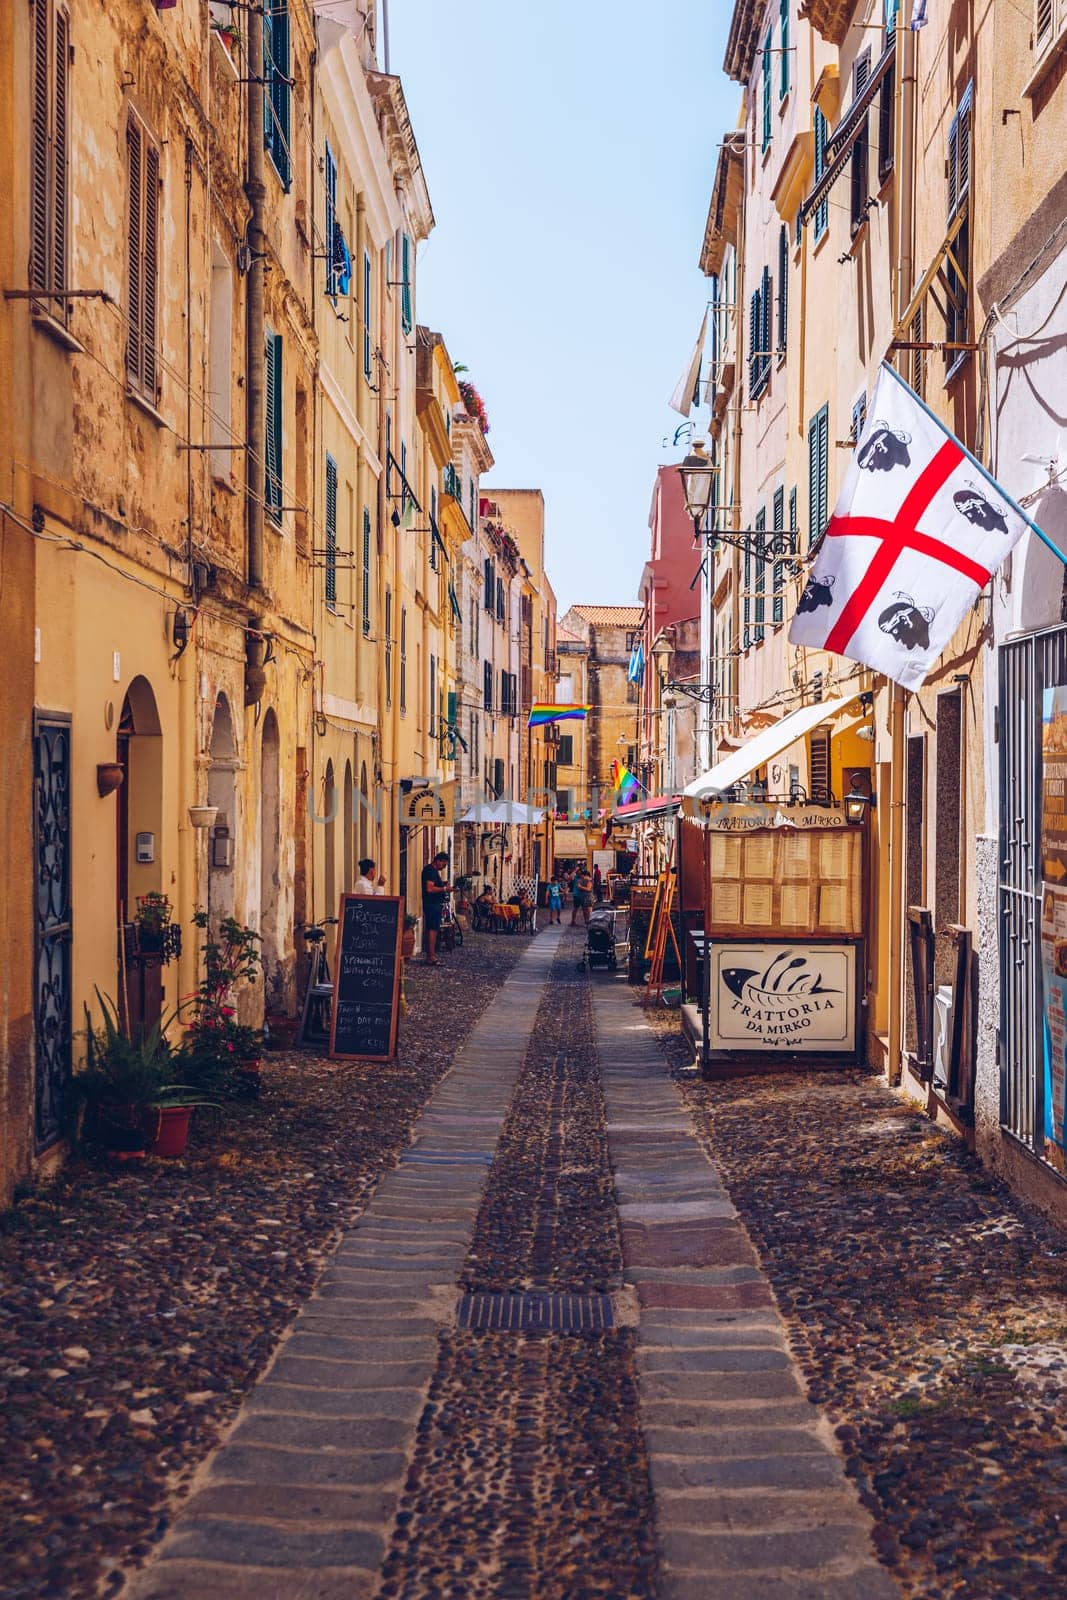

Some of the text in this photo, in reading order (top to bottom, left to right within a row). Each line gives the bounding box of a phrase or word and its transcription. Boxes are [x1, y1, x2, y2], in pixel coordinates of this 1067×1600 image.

[716, 815, 775, 829] TRATTORIA
[802, 814, 842, 825] MIRKO
[731, 999, 834, 1021] TRATTORIA
[745, 1018, 811, 1034] DA MIRKO
